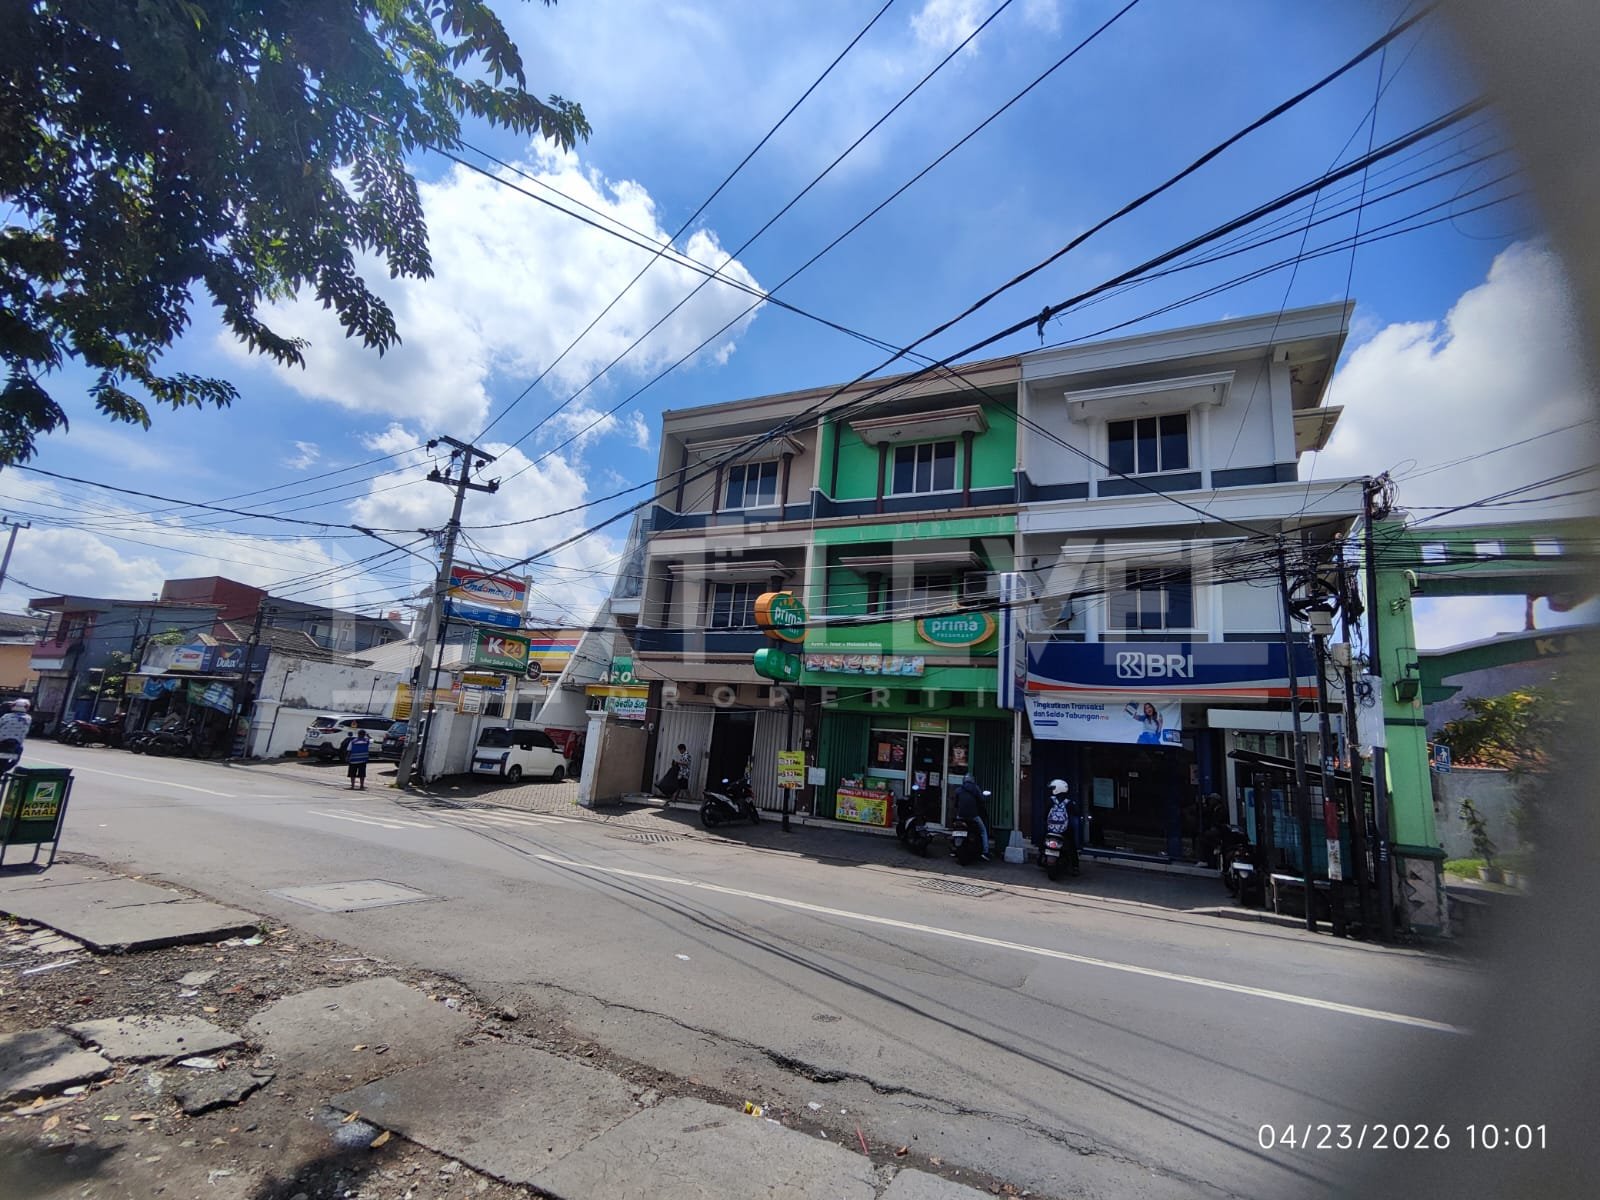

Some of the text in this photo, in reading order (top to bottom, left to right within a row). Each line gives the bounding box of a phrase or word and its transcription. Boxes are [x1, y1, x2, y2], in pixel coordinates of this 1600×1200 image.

[774, 607, 802, 624] prima
[932, 620, 979, 633] prima
[215, 657, 237, 668] Dulux
[1147, 654, 1193, 678] BRI
[1033, 701, 1104, 711] Tingkatkan Transaksi
[24, 801, 57, 809] KOTAK
[23, 808, 57, 817] AMAL
